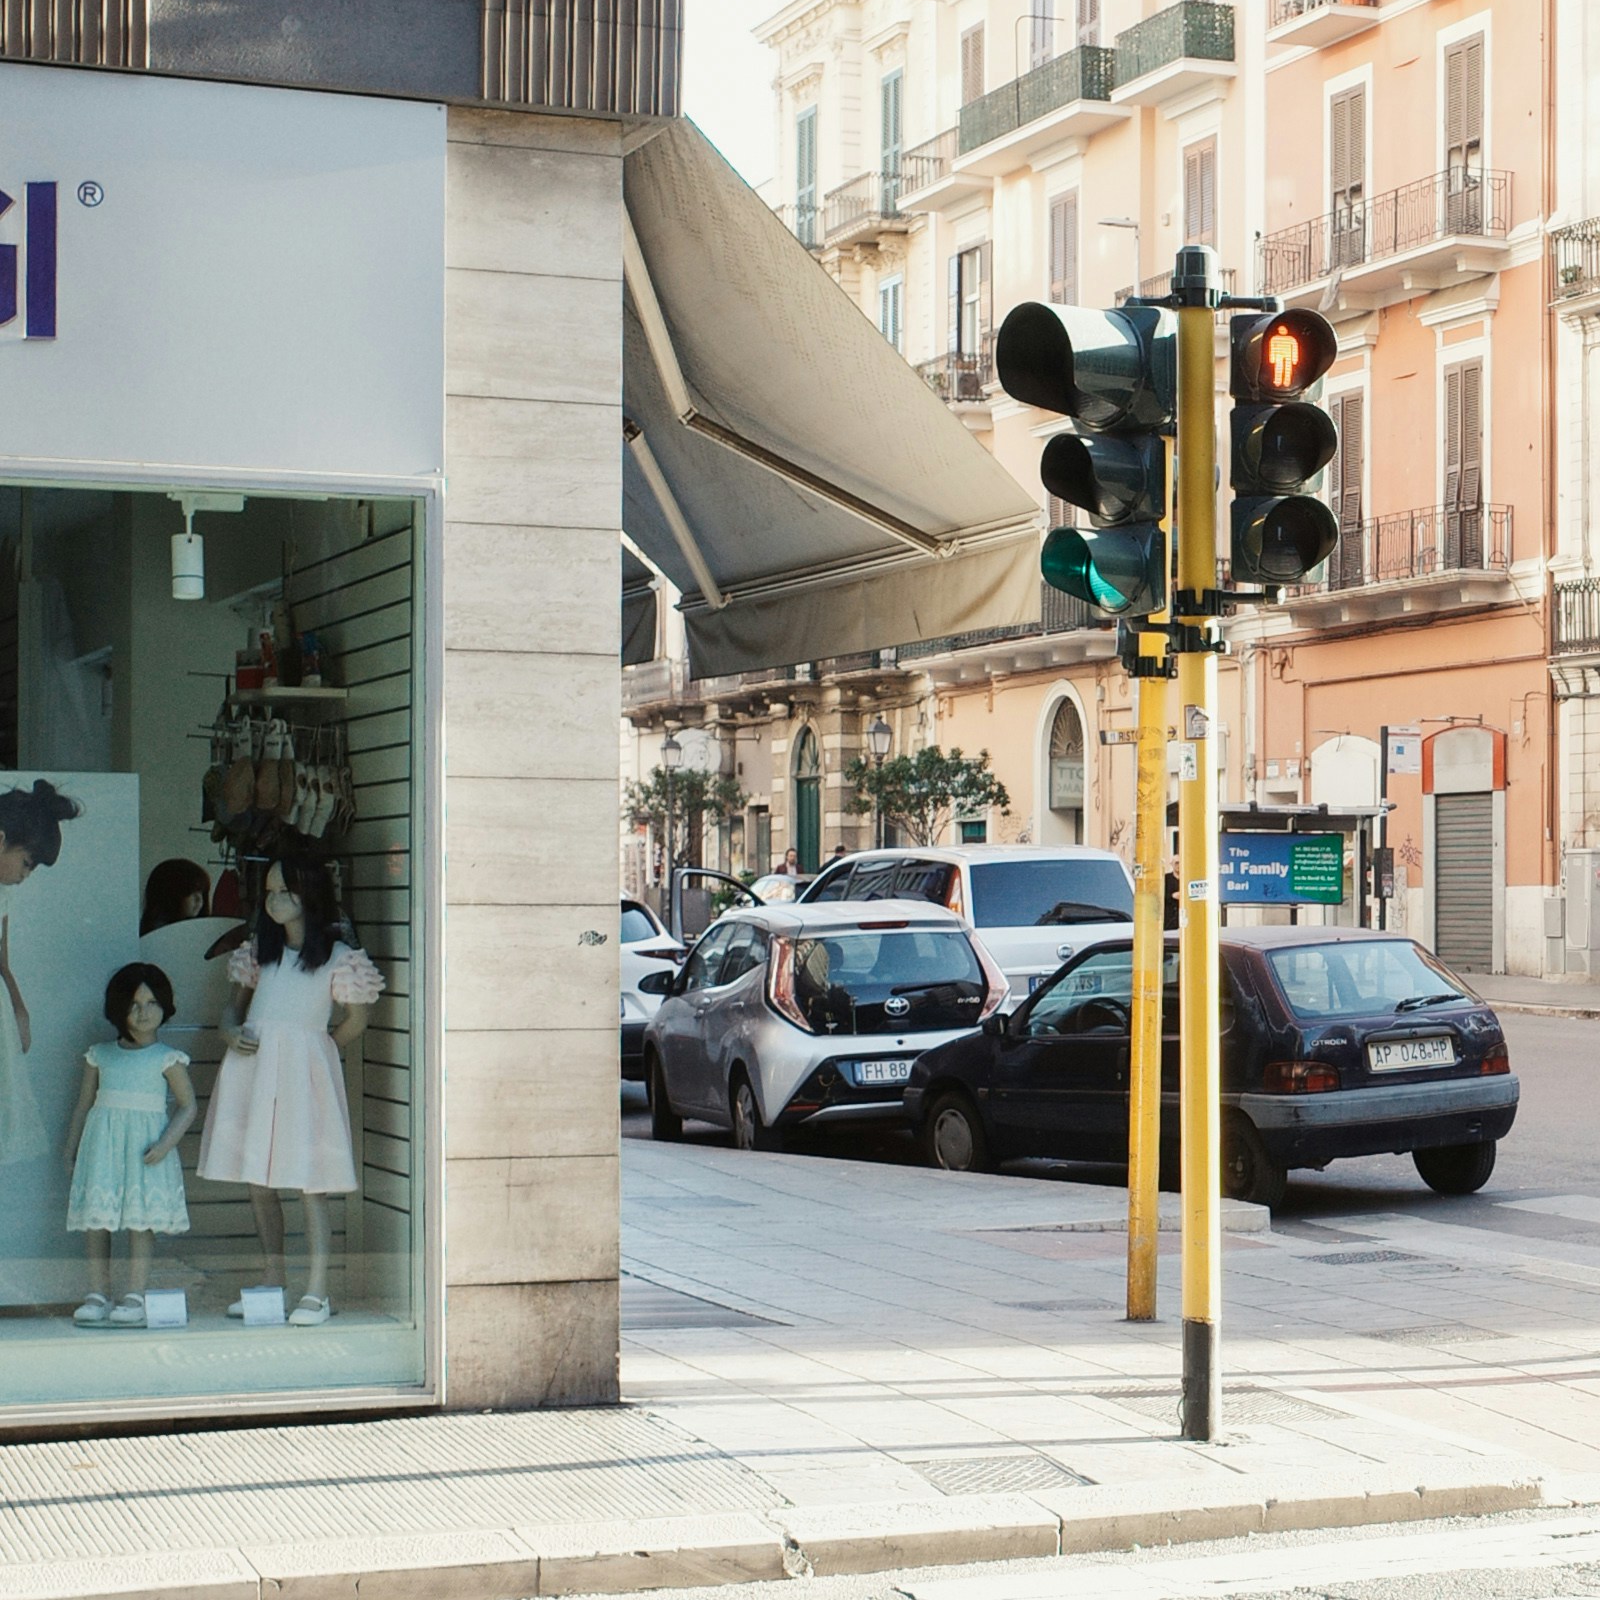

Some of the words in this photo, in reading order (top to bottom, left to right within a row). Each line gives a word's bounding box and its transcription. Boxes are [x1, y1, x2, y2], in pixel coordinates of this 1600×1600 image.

[1228, 847, 1250, 857] The
[1219, 861, 1235, 875] al
[1240, 862, 1289, 878] Family
[1226, 880, 1249, 891] Bari
[864, 1062, 884, 1079] FH
